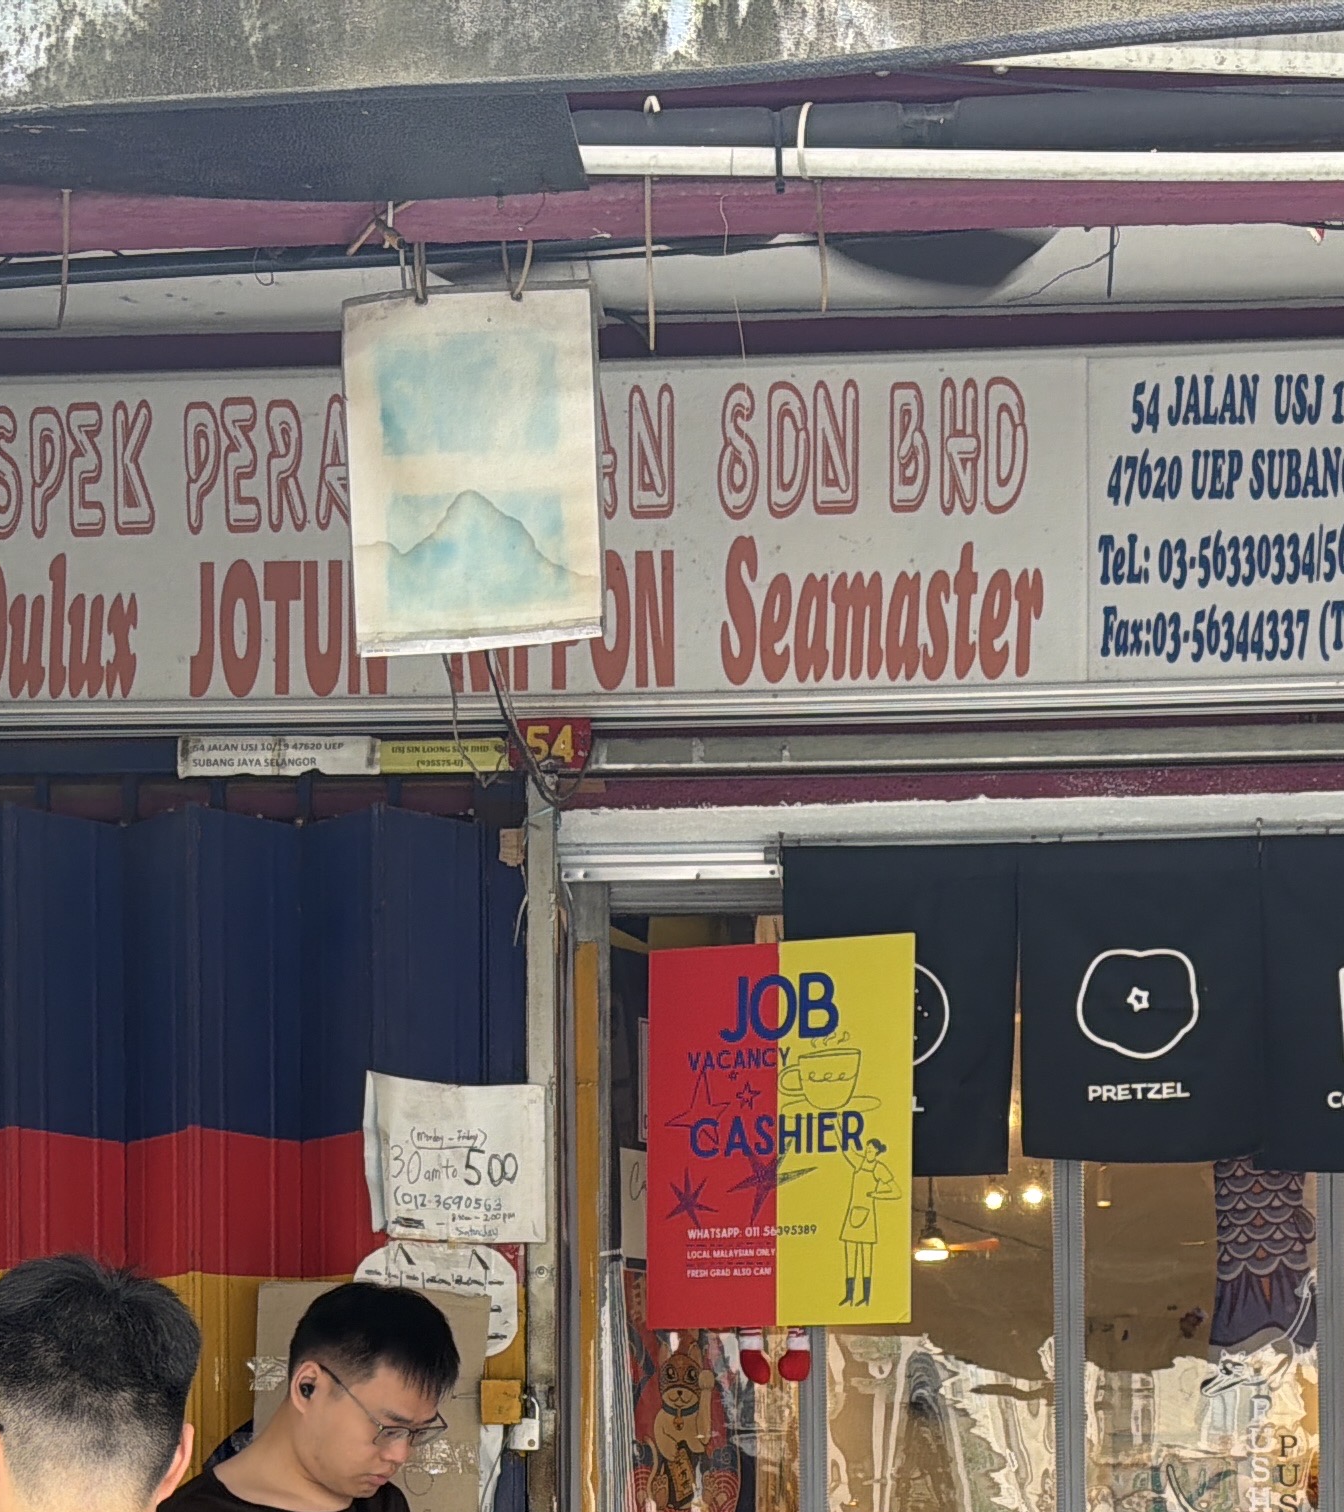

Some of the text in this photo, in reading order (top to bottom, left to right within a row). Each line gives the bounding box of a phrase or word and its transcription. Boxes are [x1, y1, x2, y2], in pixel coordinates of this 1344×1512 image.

[1132, 378, 1160, 434] 54
[1167, 374, 1258, 428] JALAN
[1274, 374, 1324, 423] USJ
[718, 379, 860, 520] SDN
[890, 376, 1029, 516] BHD
[1107, 452, 1182, 507] 47620
[1191, 448, 1242, 500] UEP
[721, 535, 1045, 688] Seamaster
[1101, 607, 1310, 666] Fax:03-56344337
[192, 757, 317, 768] SUBANG JAYA SELANGOR
[207, 743, 239, 752] JALAN
[526, 725, 574, 763] 54
[719, 972, 840, 1043] JOB
[688, 1047, 791, 1072] VACANCY
[1087, 1082, 1191, 1104] PRETZEL
[689, 1111, 865, 1159] CASHIER
[687, 1226, 742, 1240] WHATSAPP:
[744, 1226, 761, 1238] 011
[687, 1249, 711, 1260] LOCAL
[756, 1248, 776, 1257] ONLY
[687, 1268, 708, 1278] FRESH
[709, 1267, 731, 1278] GRAD
[733, 1267, 752, 1277] ALSO
